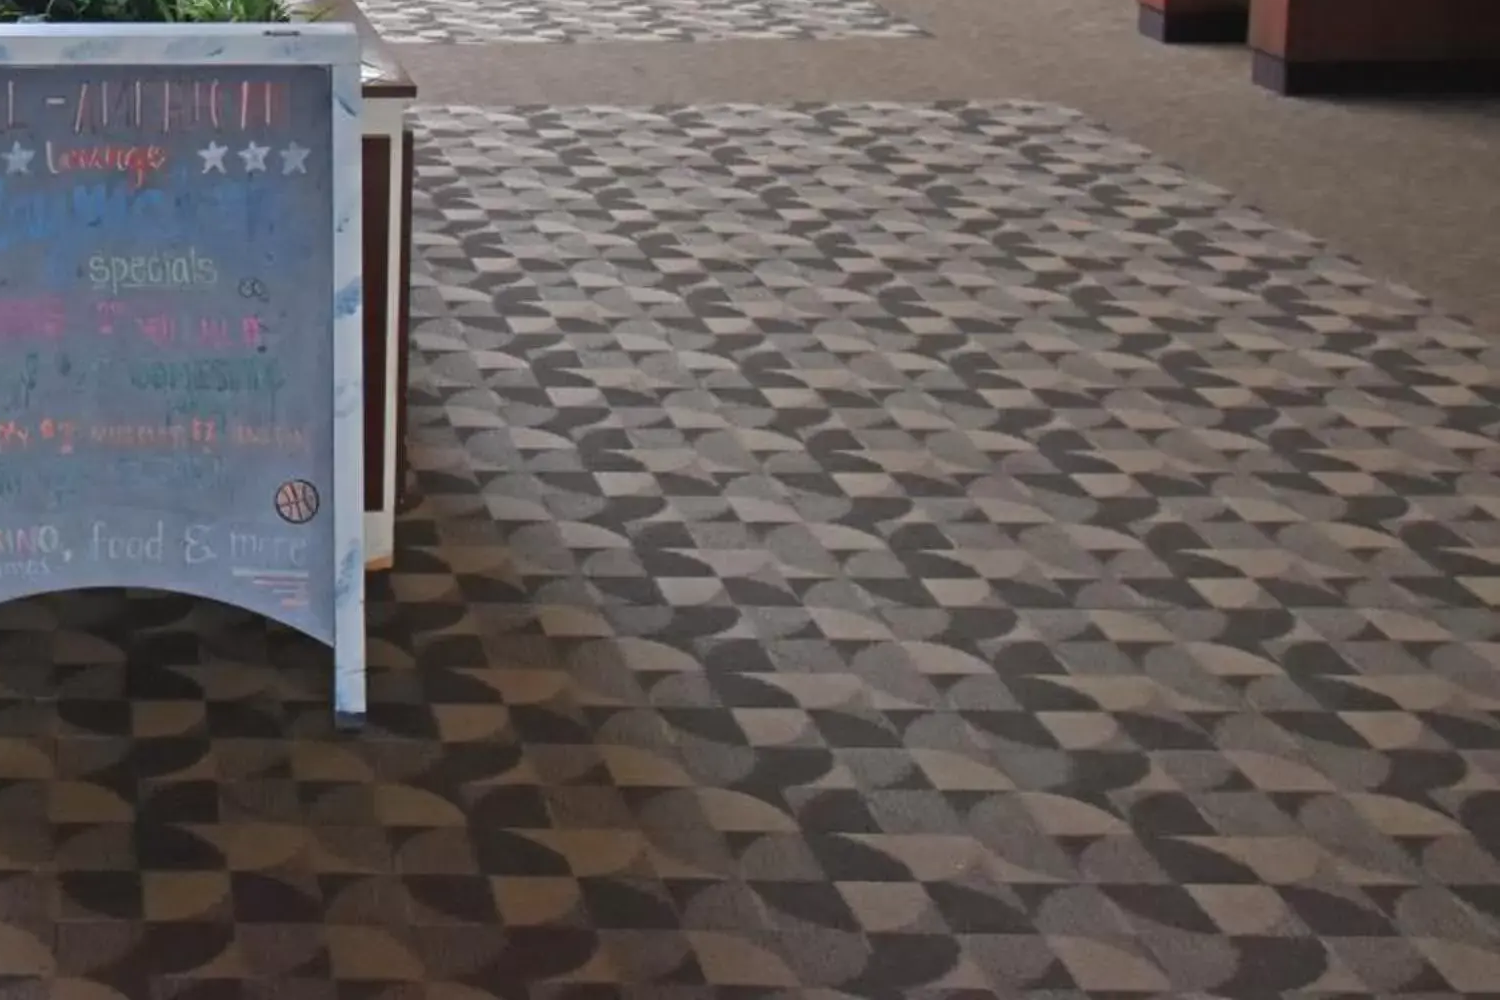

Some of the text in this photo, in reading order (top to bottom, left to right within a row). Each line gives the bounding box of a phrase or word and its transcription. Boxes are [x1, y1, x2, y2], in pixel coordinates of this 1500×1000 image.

[88, 248, 218, 297] specials
[90, 518, 165, 562] food
[183, 523, 218, 565] &
